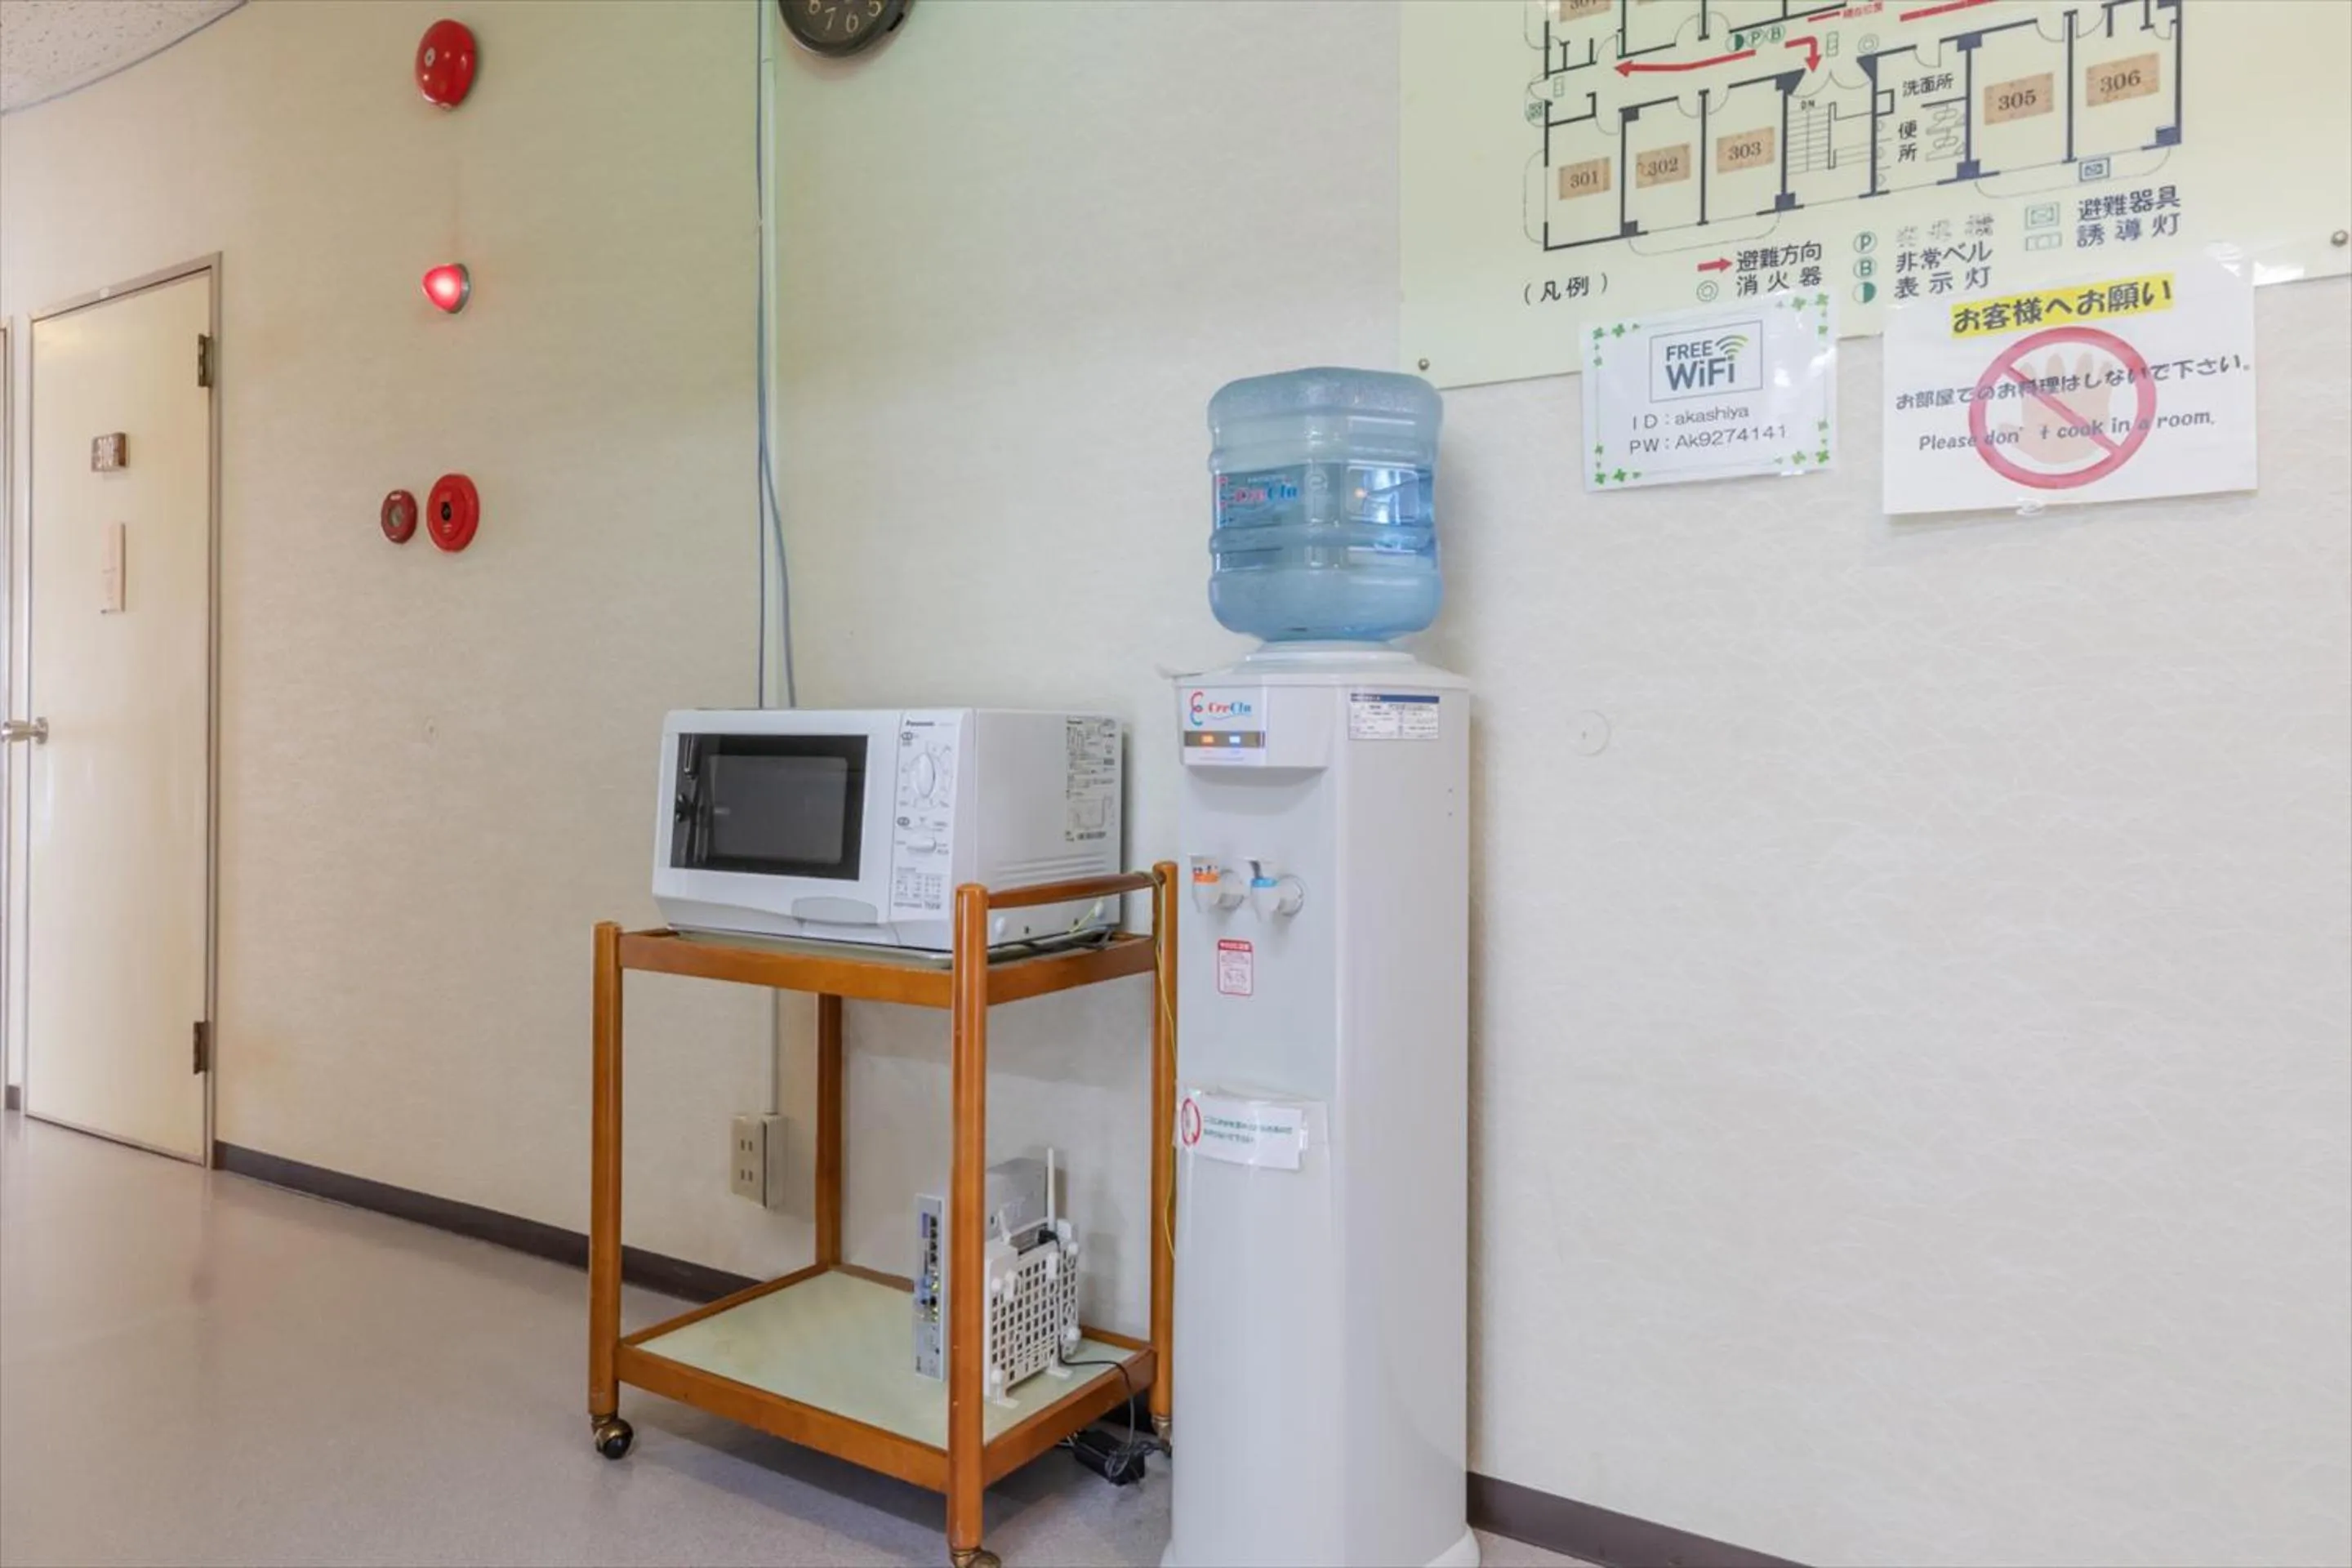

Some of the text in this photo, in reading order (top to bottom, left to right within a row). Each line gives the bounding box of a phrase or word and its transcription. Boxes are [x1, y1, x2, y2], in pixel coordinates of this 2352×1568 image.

[825, 7, 837, 31] 7
[1902, 73, 1953, 96] 洗面所
[2099, 70, 2141, 93] 306
[1998, 89, 2037, 113] 305
[1728, 141, 1762, 161] 303
[1898, 121, 1918, 163] 便所
[1648, 158, 1679, 176] 302
[1570, 171, 1599, 188] 301
[2078, 186, 2181, 221] 避難器具
[1736, 242, 1822, 274] 避難方向
[1895, 240, 1993, 274] 非常ベル
[1953, 279, 2172, 333] お客様へお願い
[1665, 340, 1713, 362] FREE
[1665, 354, 1735, 391] WiFi
[1918, 432, 1976, 451] Please
[2056, 420, 2104, 439] cook
[2111, 415, 2130, 432] in
[2137, 417, 2149, 429] a
[2156, 411, 2216, 430] room.
